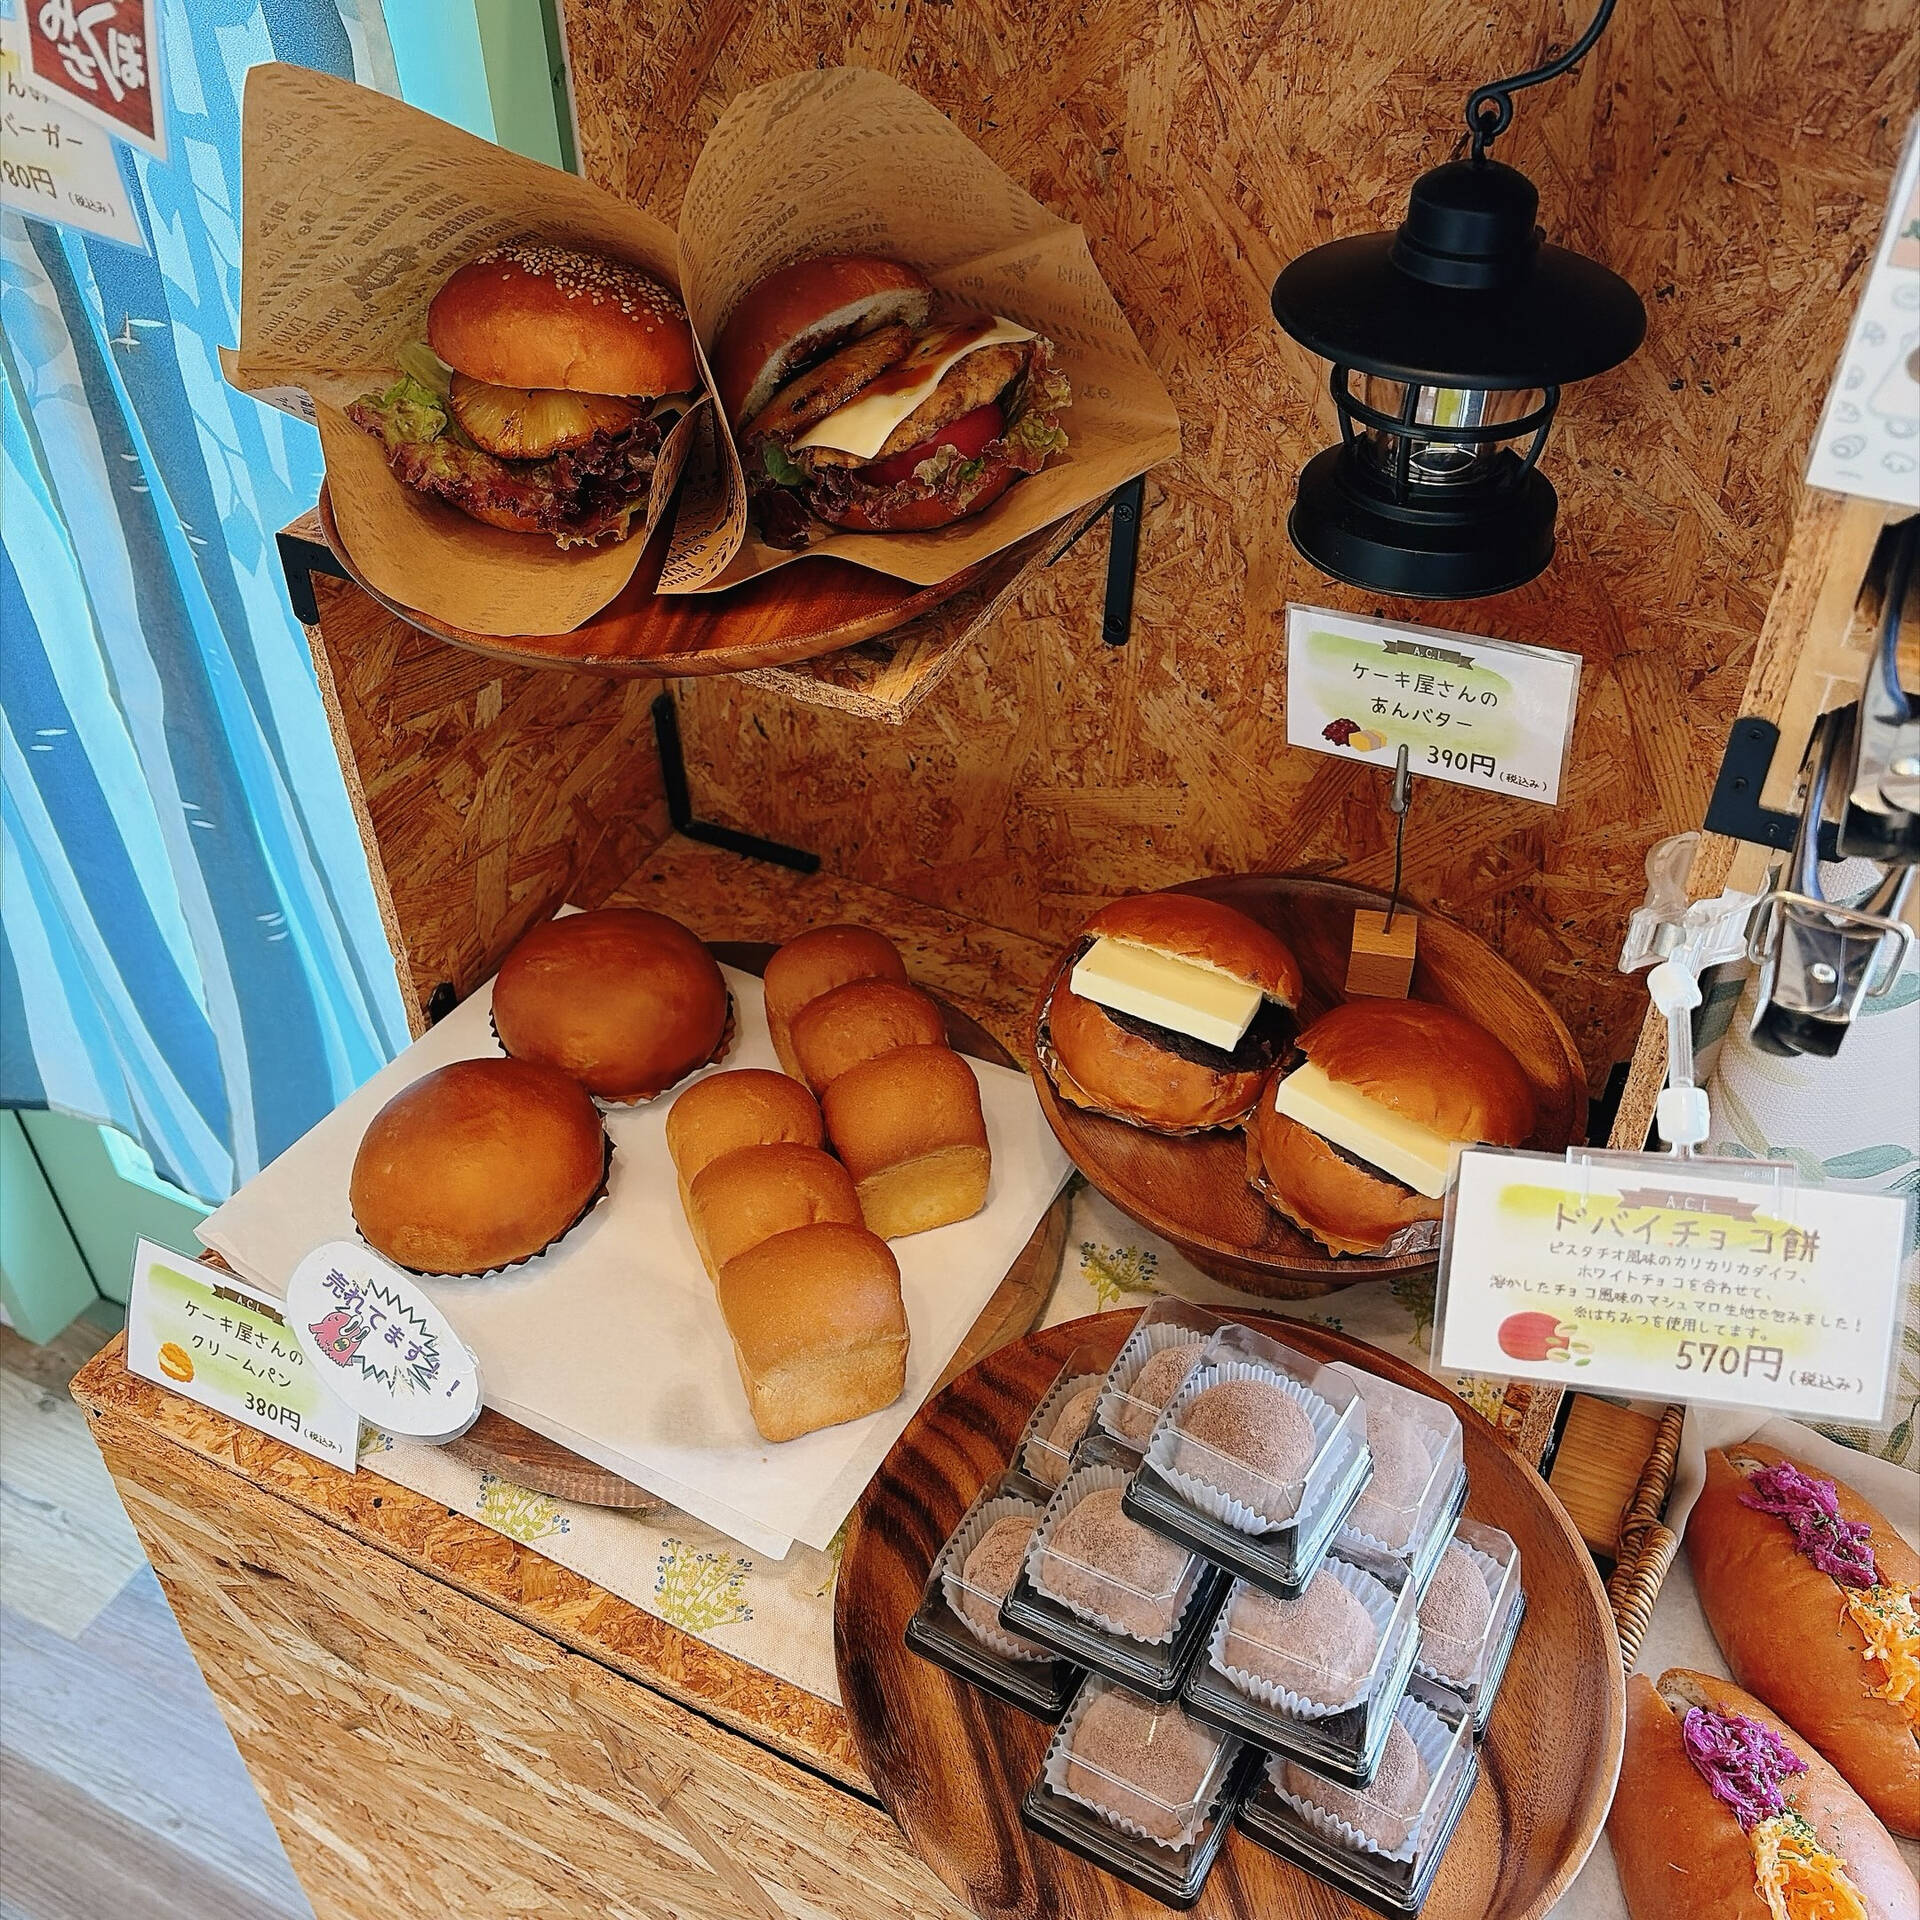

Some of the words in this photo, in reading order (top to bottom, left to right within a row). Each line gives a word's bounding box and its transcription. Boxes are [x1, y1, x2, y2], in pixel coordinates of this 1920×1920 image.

[0, 160, 57, 199] 80円
[1352, 662, 1498, 707] ケーキ屋さんの
[1370, 697, 1473, 728] あんバター
[1427, 745, 1496, 778] 390円
[1499, 771, 1548, 792] (税込み)
[1556, 1203, 1820, 1263] ドバイチョコ餅
[185, 1300, 304, 1366] ケーキ屋さんの
[191, 1335, 292, 1388] クリームパン
[1676, 1339, 1784, 1383] 570円
[1789, 1370, 1864, 1394] (税込み)
[245, 1391, 301, 1433] 380円
